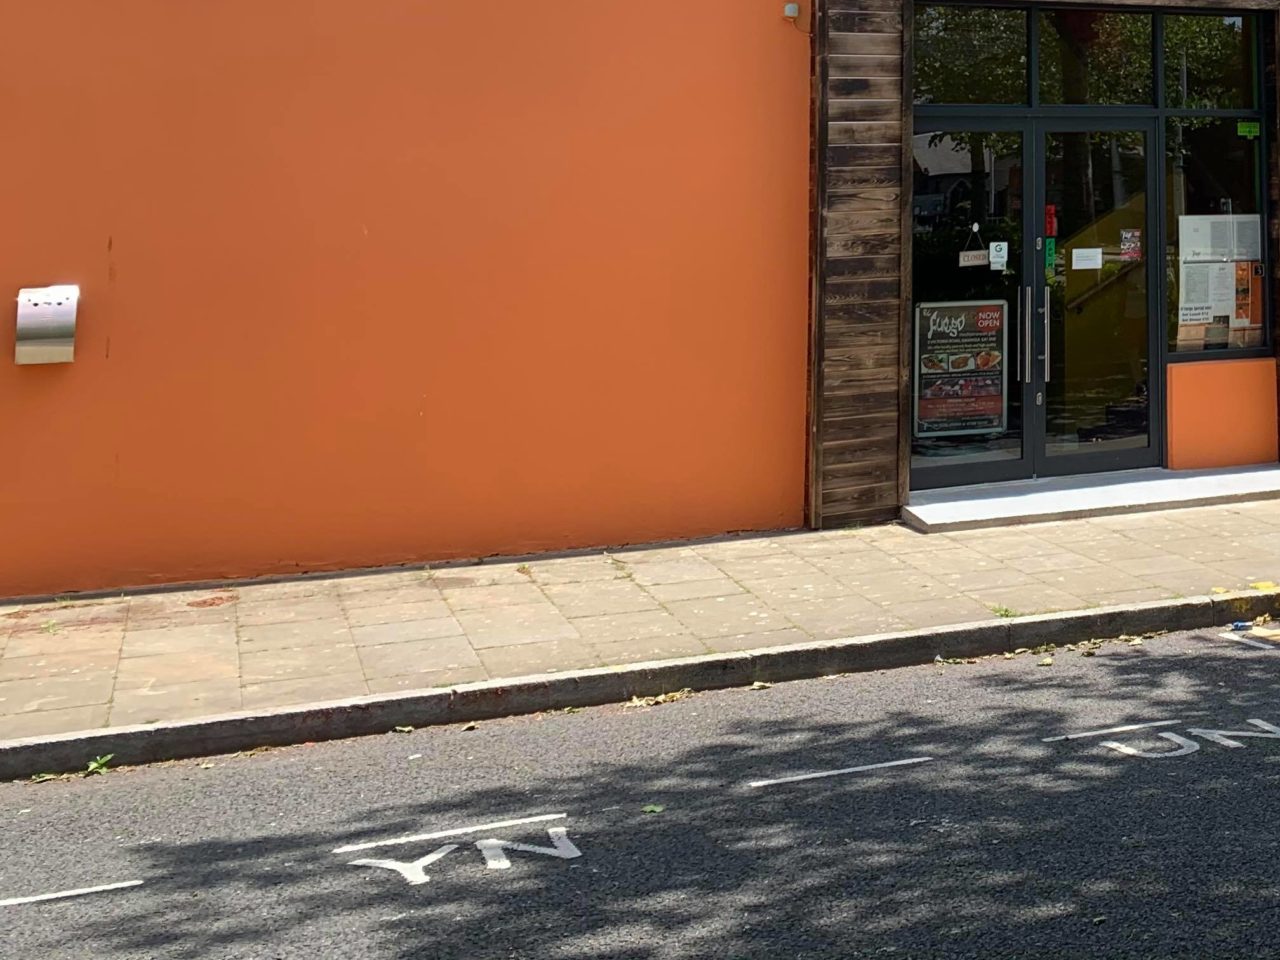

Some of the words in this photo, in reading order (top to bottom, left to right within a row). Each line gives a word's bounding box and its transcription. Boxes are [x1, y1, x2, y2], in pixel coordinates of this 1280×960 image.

[962, 253, 988, 263] CLOSED
[978, 311, 1000, 320] NOW
[977, 319, 1000, 328] OPEN
[347, 826, 583, 886] YN
